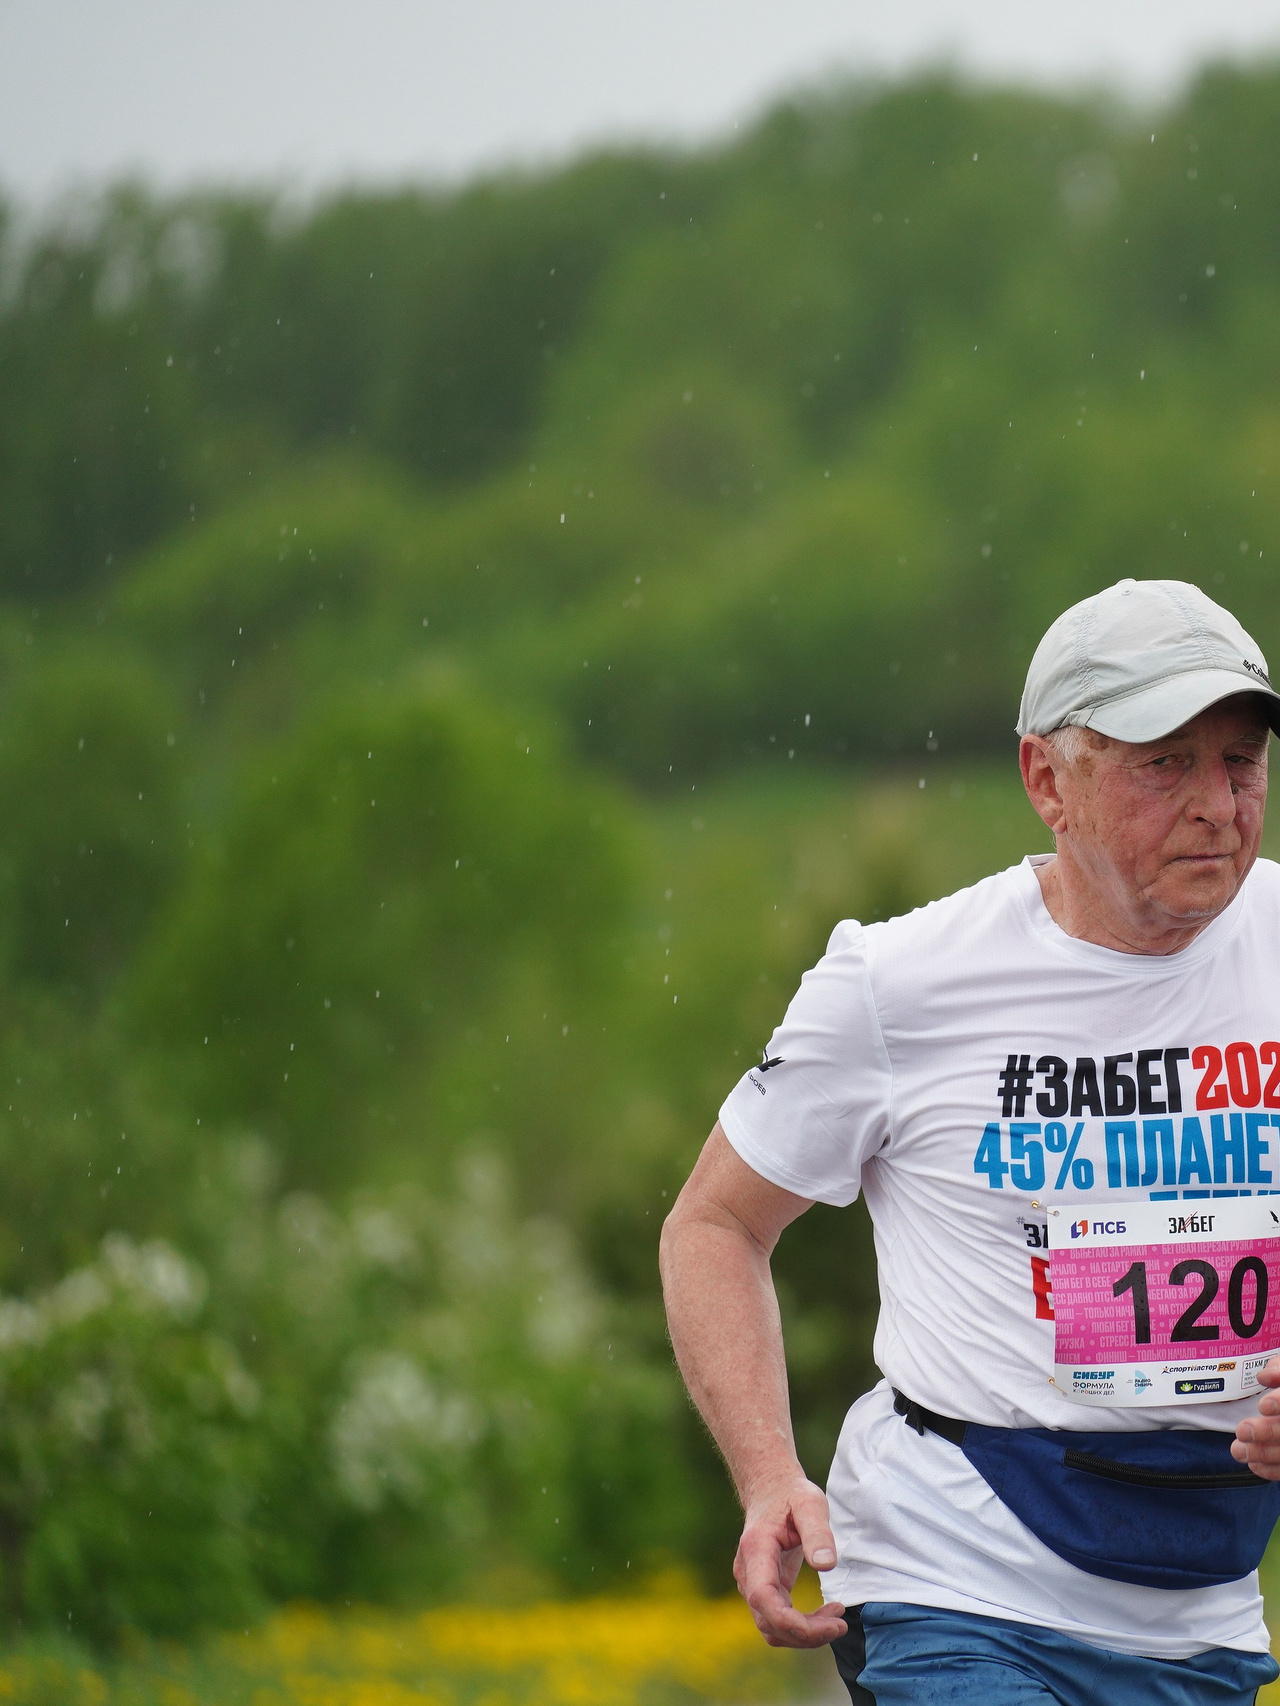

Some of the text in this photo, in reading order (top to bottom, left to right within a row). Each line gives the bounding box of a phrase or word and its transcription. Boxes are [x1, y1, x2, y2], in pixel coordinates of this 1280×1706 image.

[973, 1121, 1094, 1191] 45%
[1092, 1220, 1127, 1235] ПСБ
[1168, 1215, 1216, 1234] ЗАБЕГ
[1109, 1247, 1120, 1258] ЗА
[1120, 1244, 1148, 1257] РАМКИ
[1090, 1262, 1101, 1274] НА
[1101, 1260, 1131, 1273] СТАРТЕ
[1071, 1277, 1084, 1289] БЕГ
[1085, 1276, 1092, 1288] В
[1092, 1275, 1111, 1288] СЕБЕ
[1068, 1292, 1095, 1306] ДАВНО
[1178, 1287, 1189, 1299] ЗА
[1112, 1256, 1269, 1345] 120
[1055, 1308, 1075, 1321] НИШ
[1084, 1306, 1115, 1320] ТОЛЬКО
[1158, 1303, 1170, 1316] НА
[1091, 1321, 1115, 1334] ЛЮБИ
[1115, 1320, 1130, 1333] БЕГ
[1100, 1335, 1130, 1348] СТРЕСС
[1095, 1346, 1197, 1364] ФИНИШ ТОЛЬКО НАЧАЛО
[1208, 1345, 1220, 1358] НА
[1219, 1343, 1243, 1357] СТАРТЕ
[1055, 1353, 1080, 1364] ДЦЕМ
[1218, 1362, 1237, 1372] PRO
[1072, 1371, 1115, 1380] СИБУР
[1072, 1381, 1115, 1389] ФОРМУЛА
